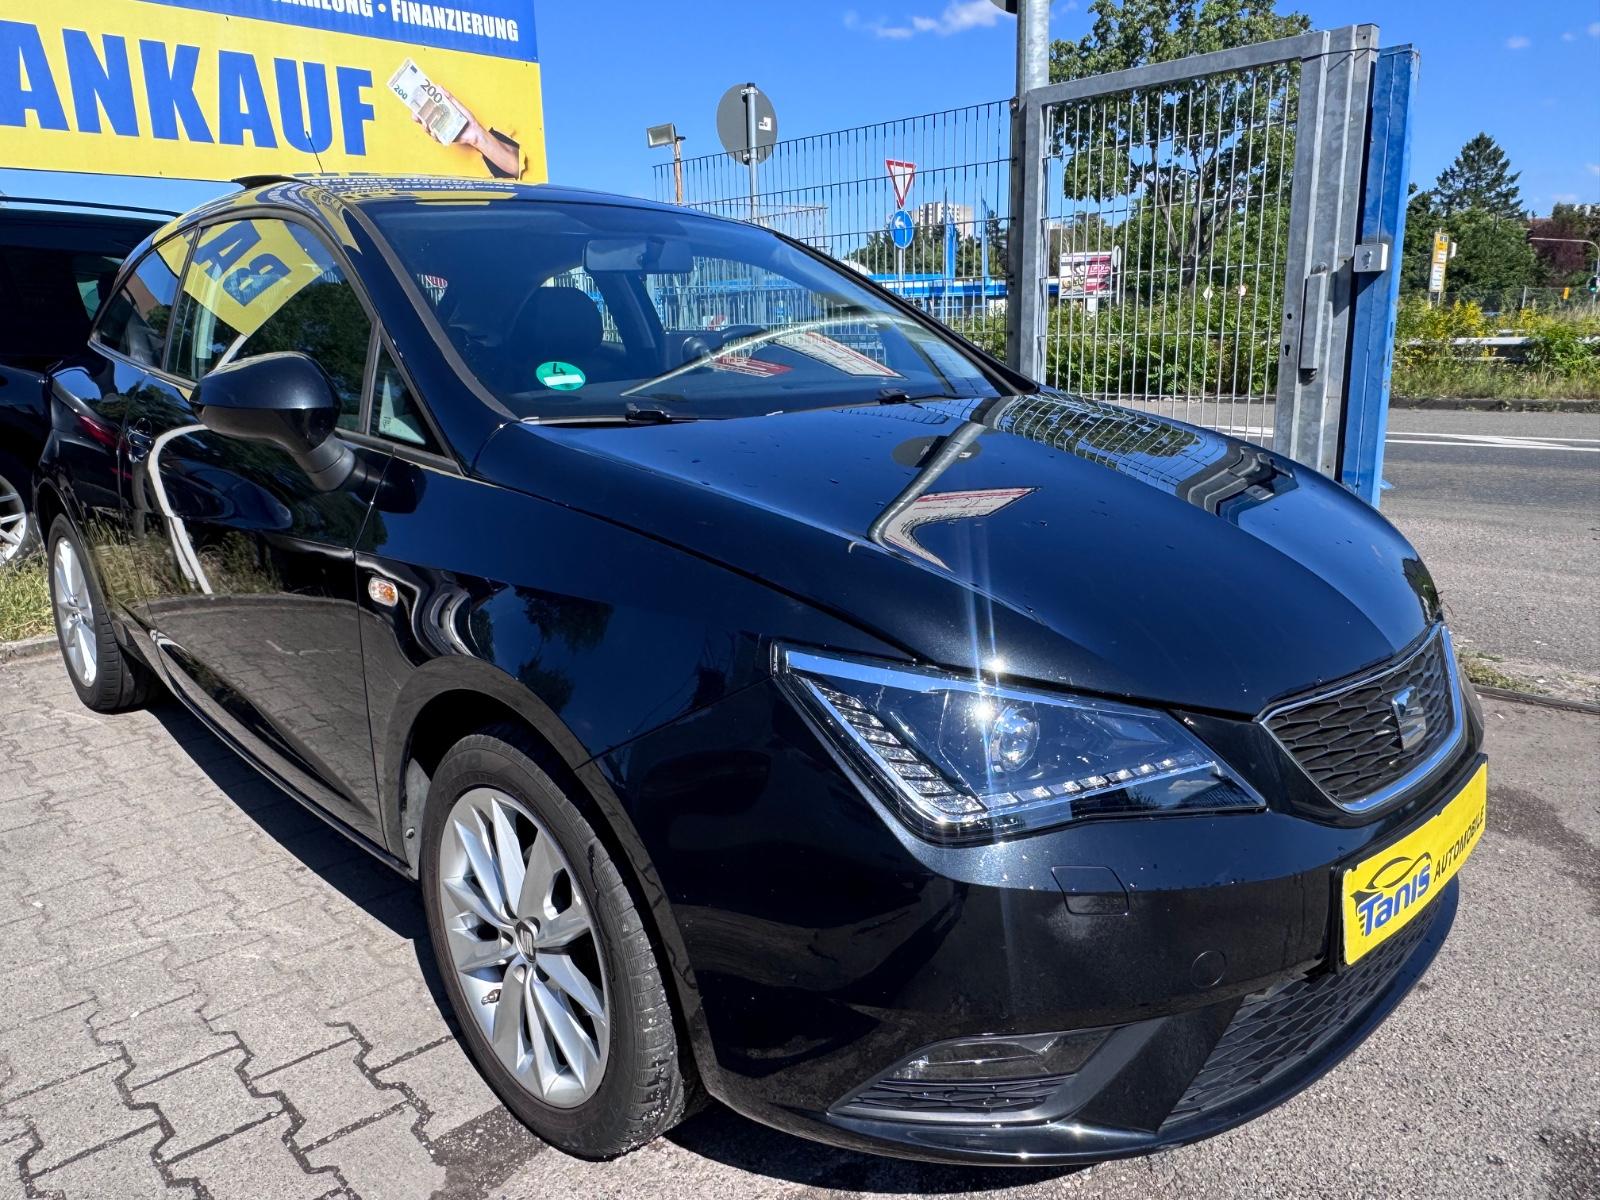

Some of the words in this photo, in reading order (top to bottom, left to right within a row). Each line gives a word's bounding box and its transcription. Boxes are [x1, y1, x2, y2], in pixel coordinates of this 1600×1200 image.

[392, 0, 519, 42] FINANZIERUNG
[0, 20, 375, 157] ANKAUF
[393, 84, 408, 100] 200
[420, 78, 443, 104] 200
